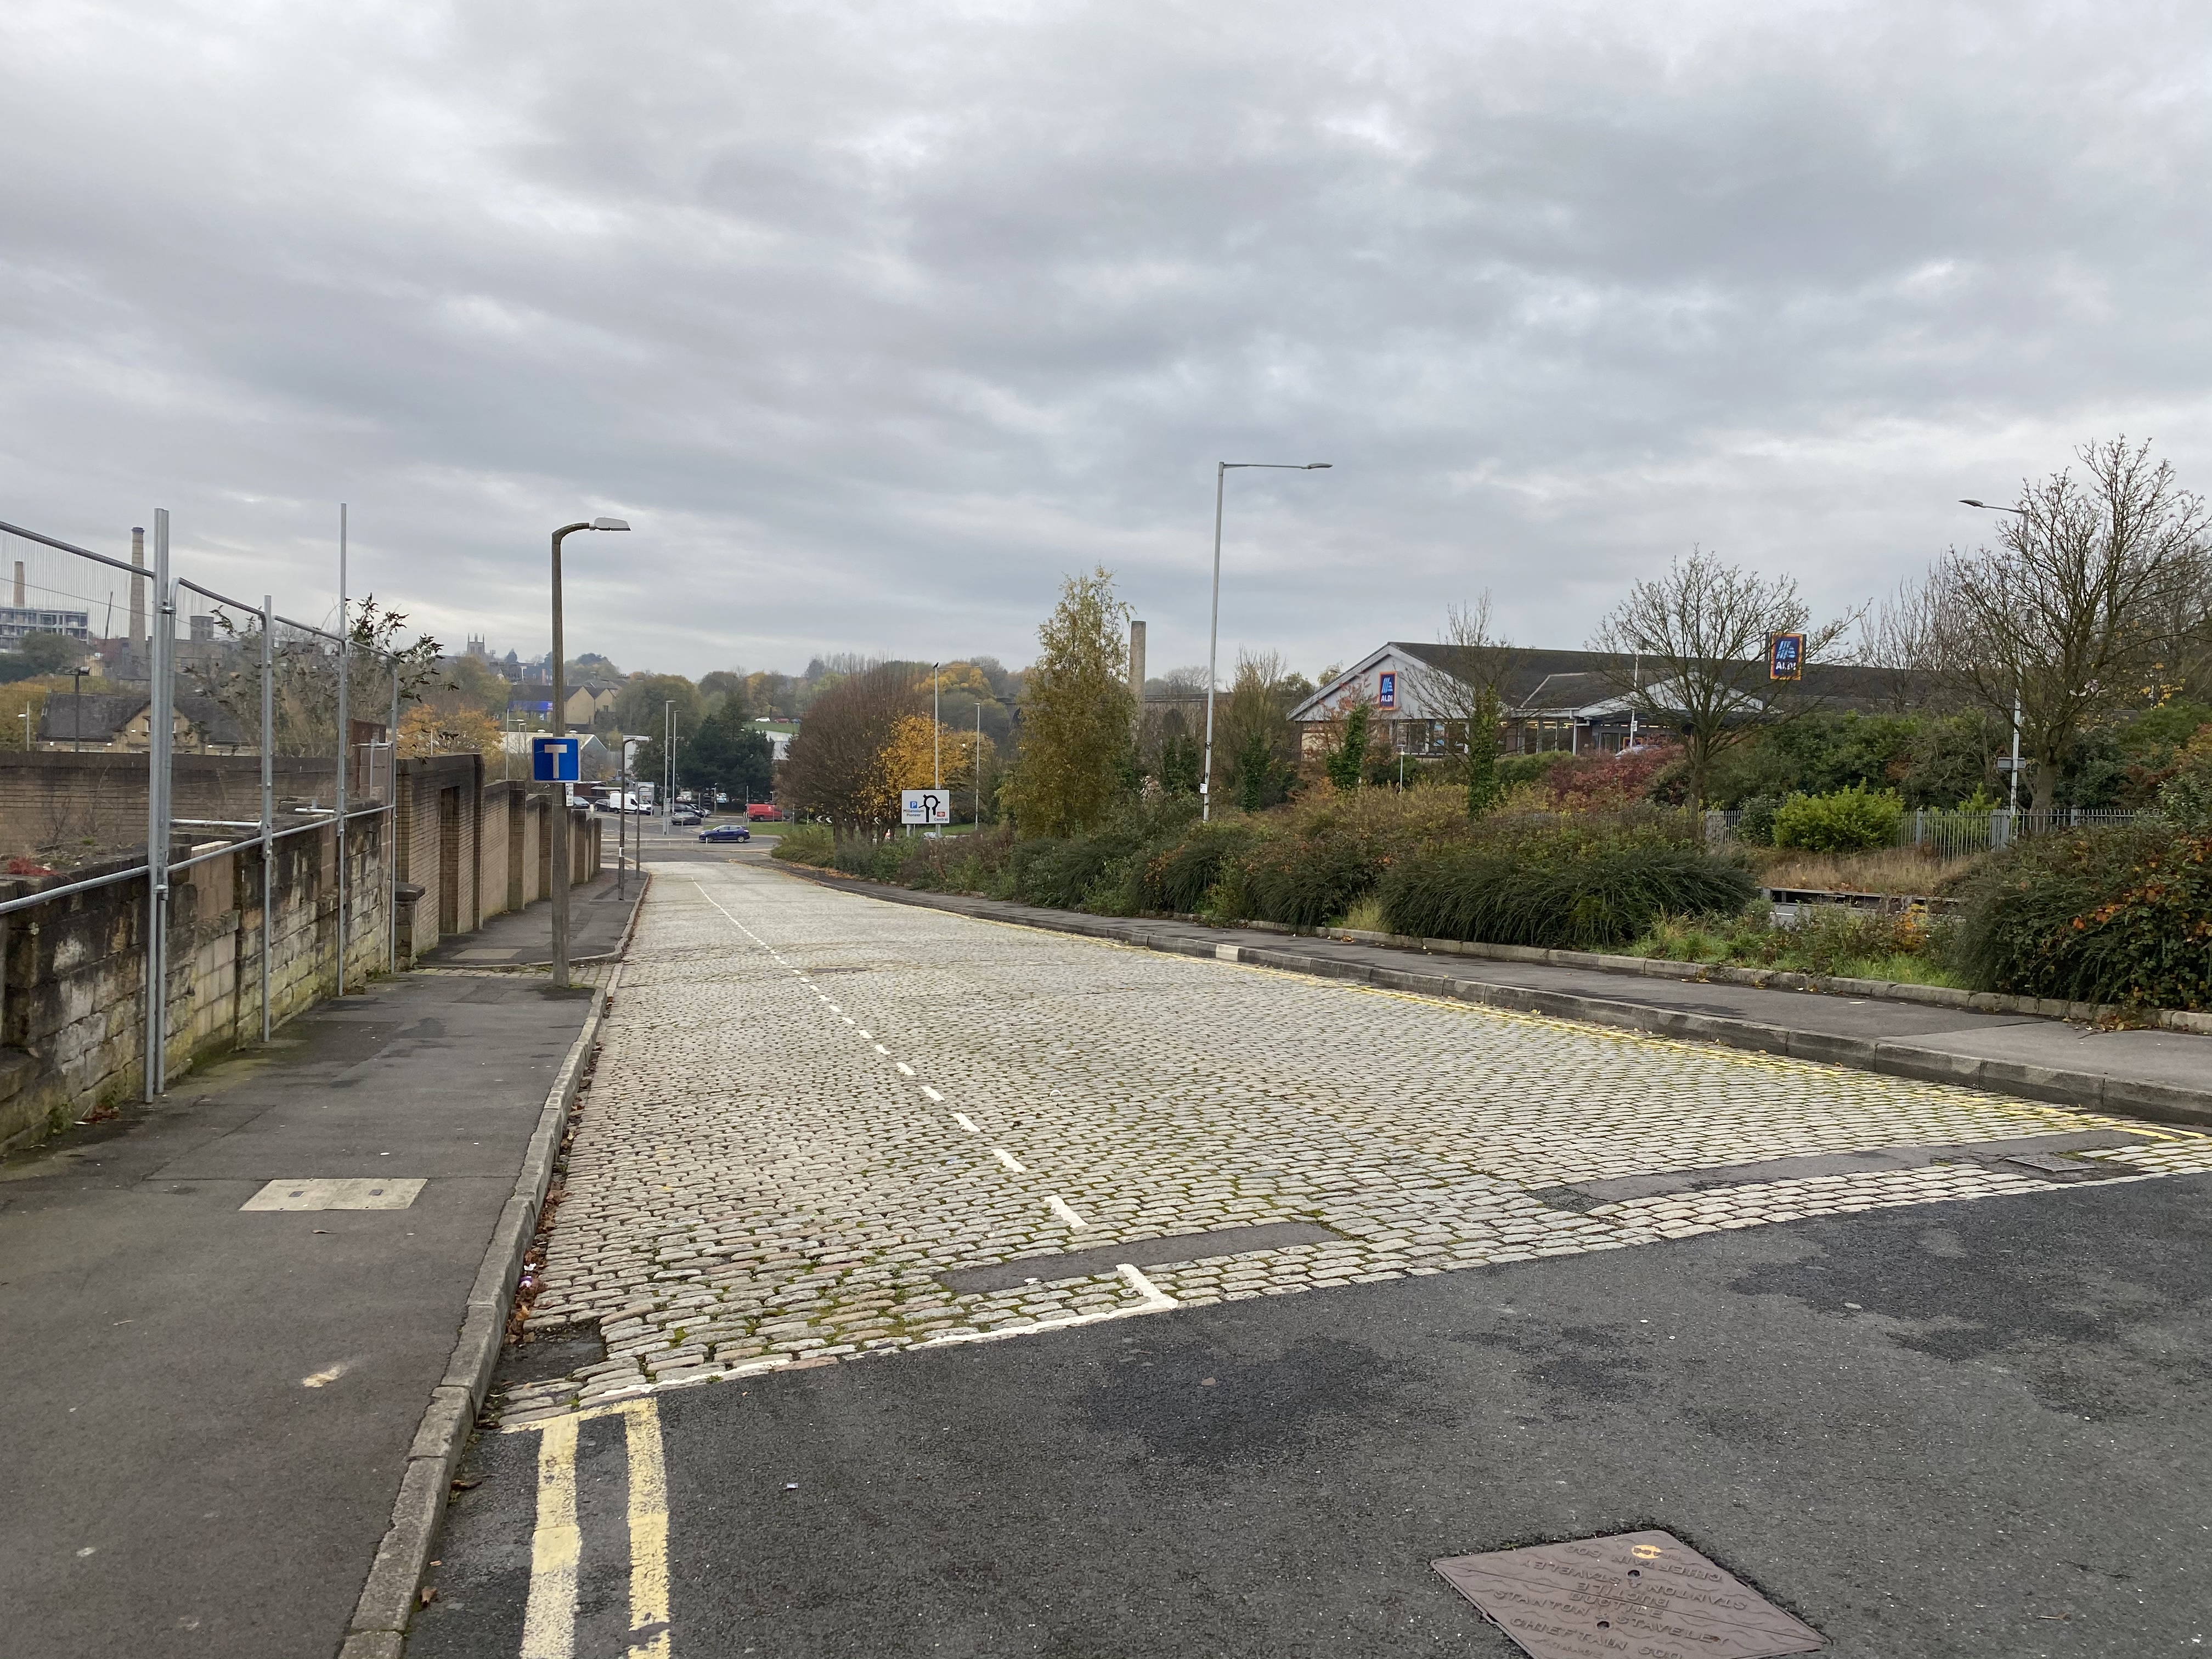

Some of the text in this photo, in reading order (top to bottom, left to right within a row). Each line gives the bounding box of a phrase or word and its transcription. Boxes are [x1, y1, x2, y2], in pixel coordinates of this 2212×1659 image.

[1520, 1560, 1622, 1585] STAVELEY
[1564, 1545, 1723, 1582] CHIEFTAIN 600
[1569, 1592, 1663, 1619] DUCTILE
[1577, 1582, 1670, 1608] DUCTILE
[1646, 1585, 1748, 1611] STANTON
[1494, 1590, 1591, 1617] STANTON
[1616, 1616, 1730, 1645] STAVELEY
[1510, 1618, 1629, 1651] CHIEFTAIN
